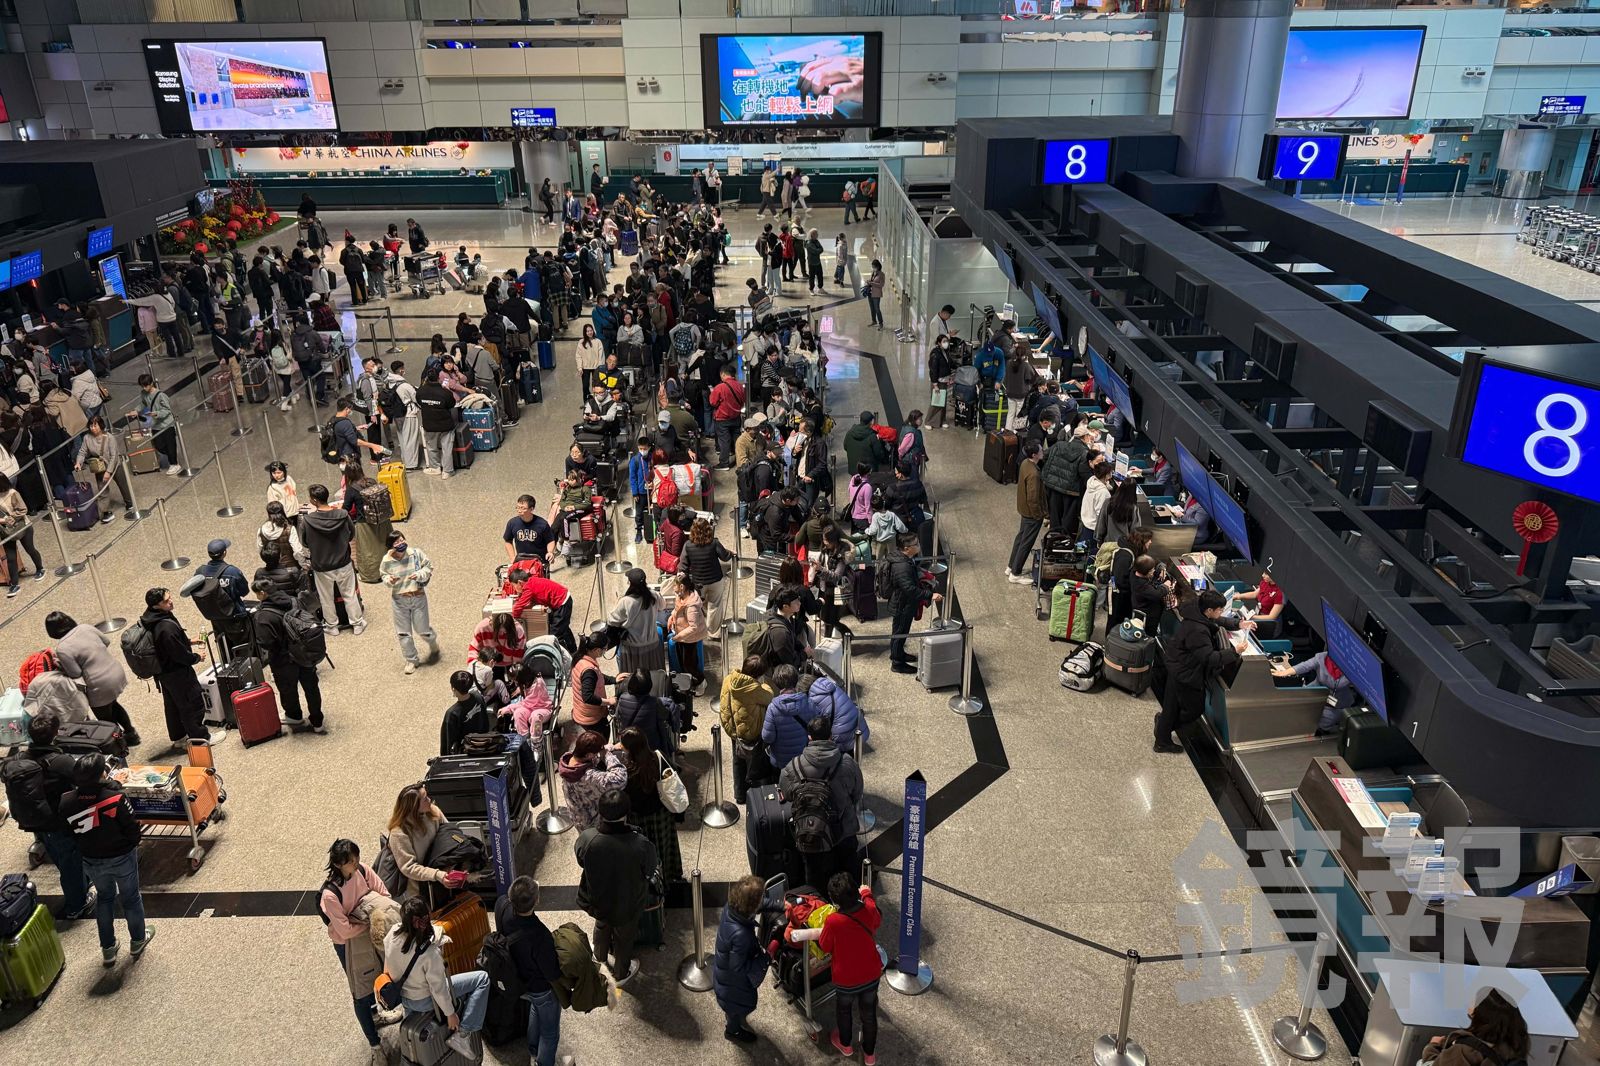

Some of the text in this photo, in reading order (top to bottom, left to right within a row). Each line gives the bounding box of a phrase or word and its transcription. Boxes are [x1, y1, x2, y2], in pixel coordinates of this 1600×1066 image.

[355, 148, 393, 158] CHINA
[1065, 144, 1086, 180] 8
[1297, 141, 1319, 175] 9
[73, 251, 81, 260] 10
[1523, 393, 1587, 477] 8
[517, 529, 538, 542] GAP
[1266, 557, 1274, 573] 2
[1412, 721, 1418, 739] 1
[908, 805, 921, 850] 豪華經濟艙
[494, 832, 502, 865] Economy
[908, 855, 917, 886] Premium
[905, 887, 916, 917] Economy
[906, 918, 915, 936] Class
